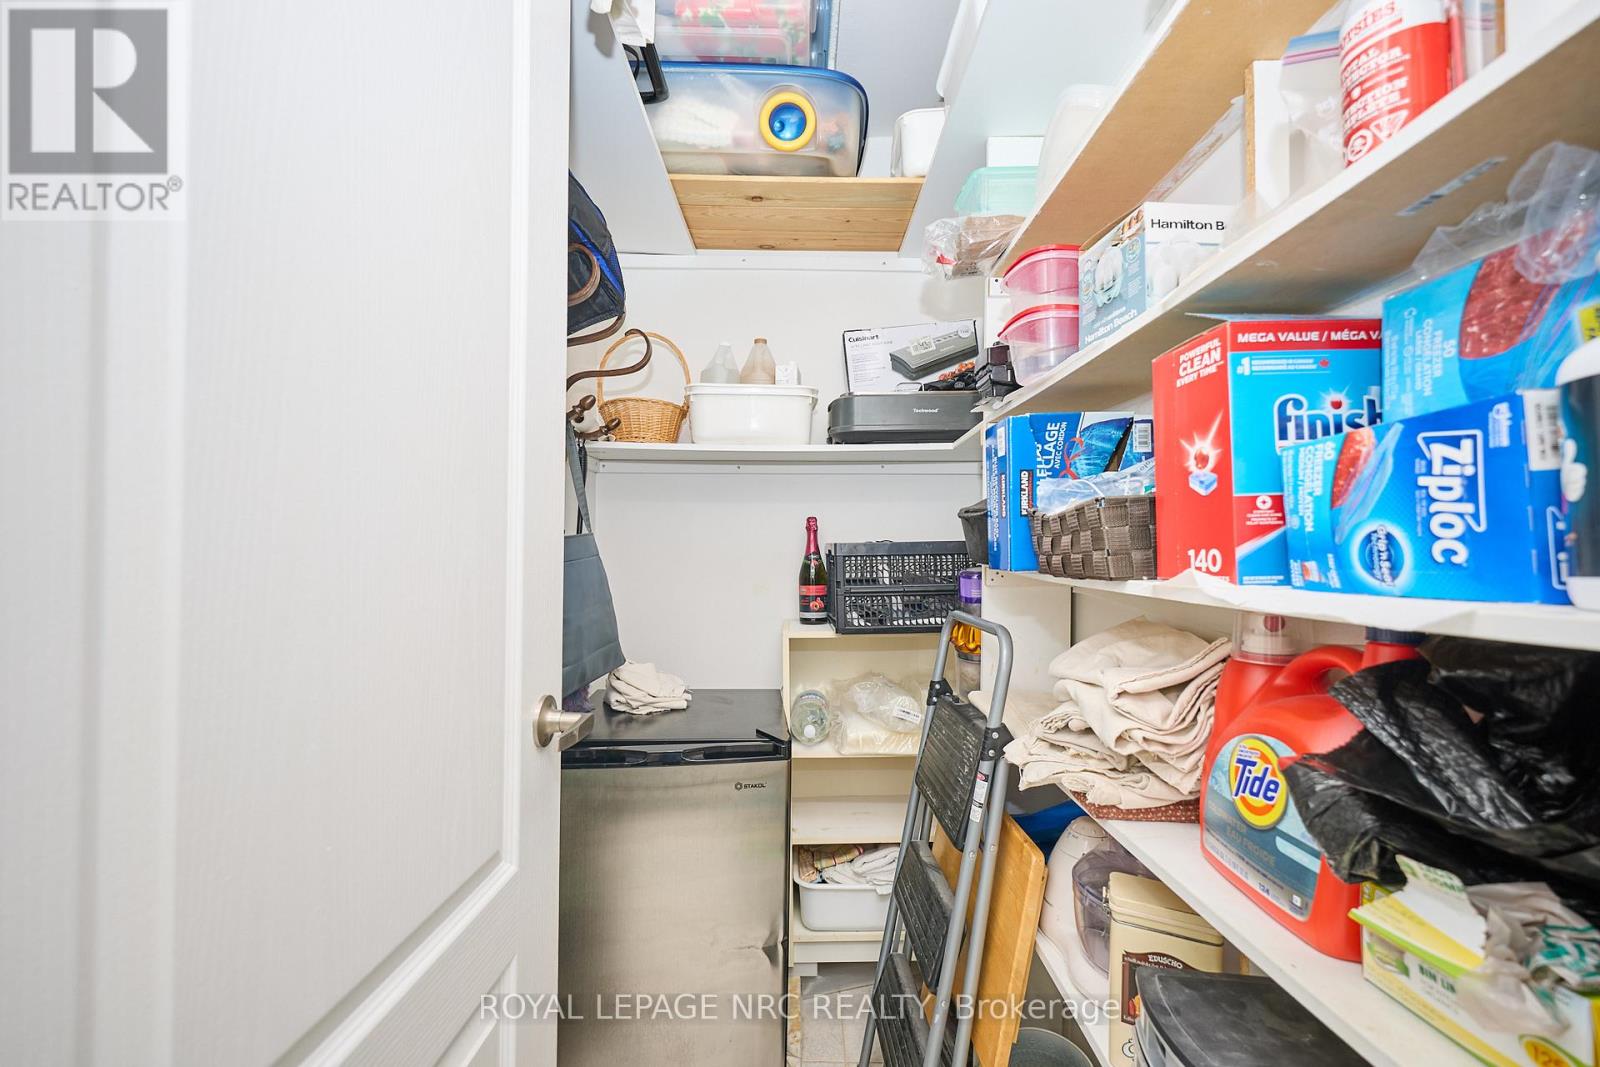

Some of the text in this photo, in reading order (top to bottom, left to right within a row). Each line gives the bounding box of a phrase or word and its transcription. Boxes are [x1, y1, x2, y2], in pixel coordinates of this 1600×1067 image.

[1150, 219, 1213, 231] Hamilton
[848, 334, 879, 343] Cuisinart
[1084, 323, 1114, 345] Hamilton
[1237, 331, 1275, 343] MEGA
[1278, 331, 1320, 342] VALUE
[1330, 328, 1368, 341] MÉGA
[1178, 346, 1221, 377] CLEAN
[1179, 337, 1222, 364] POWERFUL
[1176, 365, 1218, 389] EVERY TIME
[1053, 422, 1068, 469] AVEC CORDON
[1324, 441, 1336, 461] 60
[1313, 444, 1324, 497] FREEZER
[1020, 470, 1029, 515] KIRKLAND
[1416, 438, 1476, 565] Ziploc
[1187, 548, 1223, 574] 140
[1233, 758, 1281, 803] Tide
